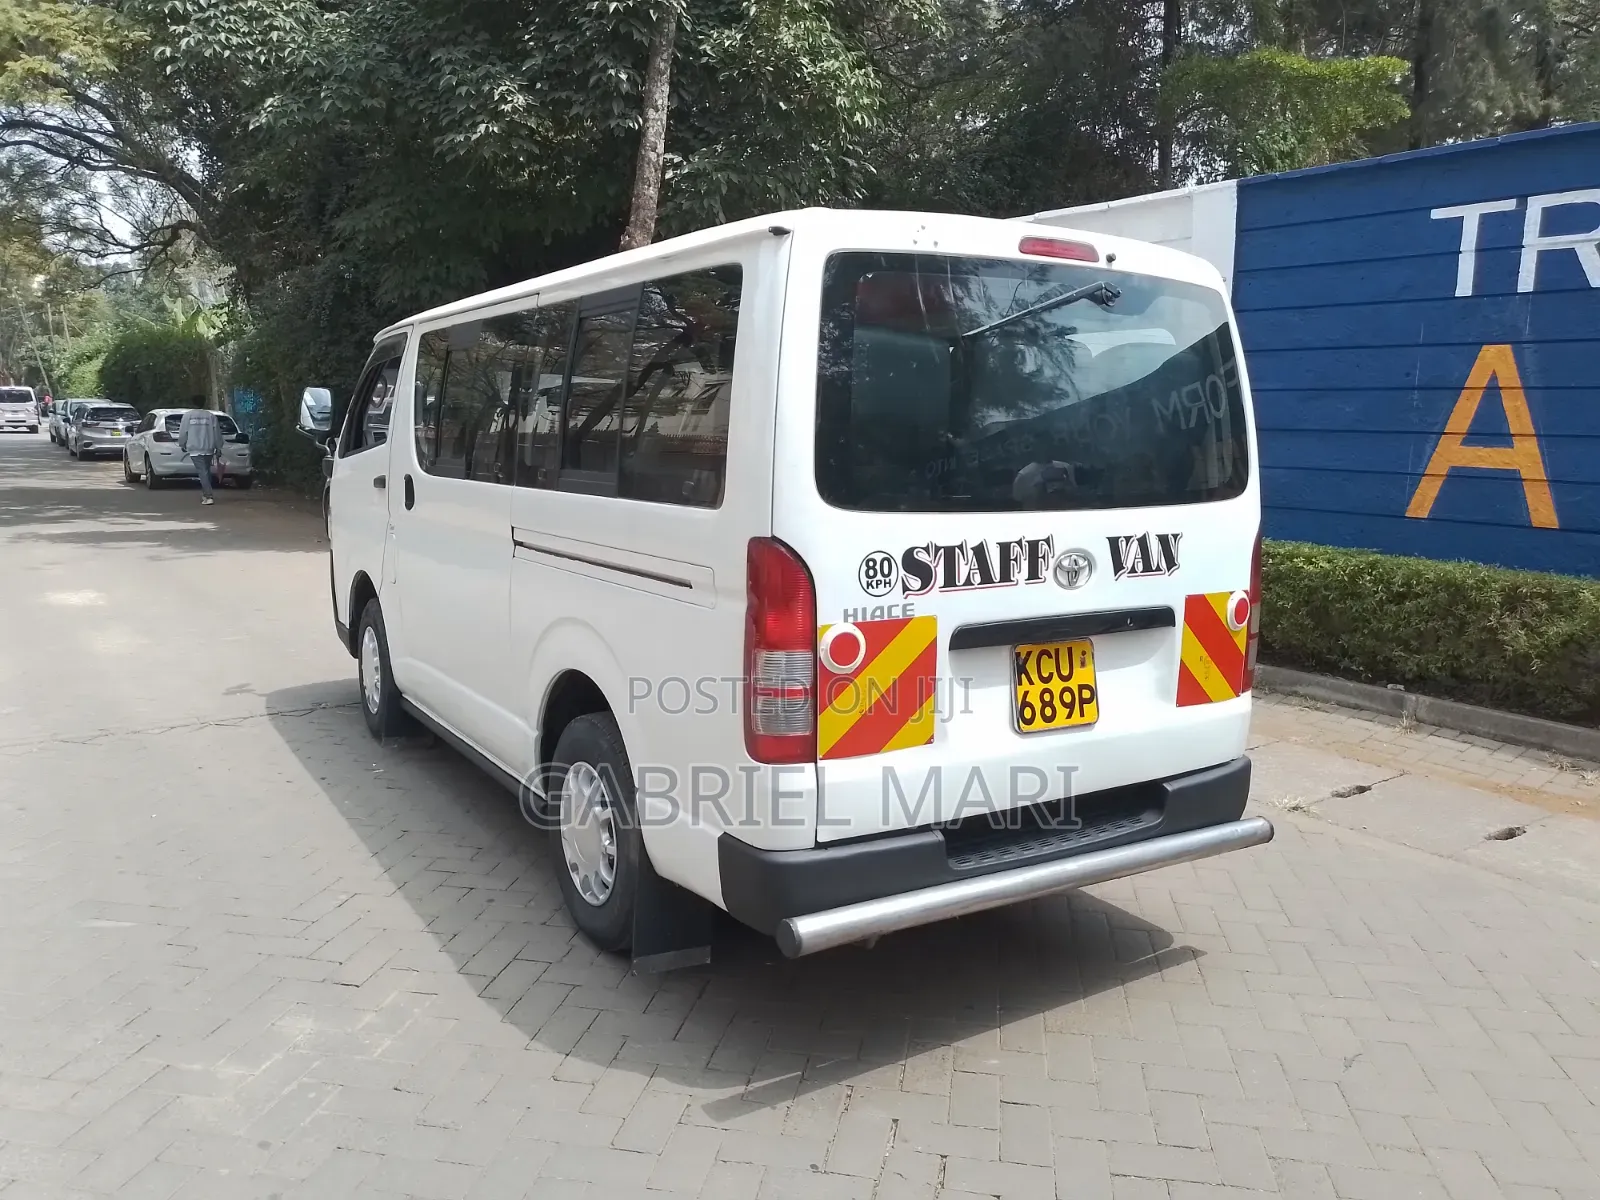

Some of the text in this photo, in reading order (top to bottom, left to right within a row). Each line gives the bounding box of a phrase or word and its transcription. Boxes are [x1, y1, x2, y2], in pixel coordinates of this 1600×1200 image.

[1430, 188, 1600, 297] TR
[1405, 344, 1560, 529] A
[864, 556, 893, 580] 80
[866, 578, 892, 590] KPH
[900, 531, 1183, 599] STAFF VAN
[842, 602, 916, 623] HIACE
[1015, 646, 1075, 687] KCU
[1019, 683, 1096, 726] 689P
